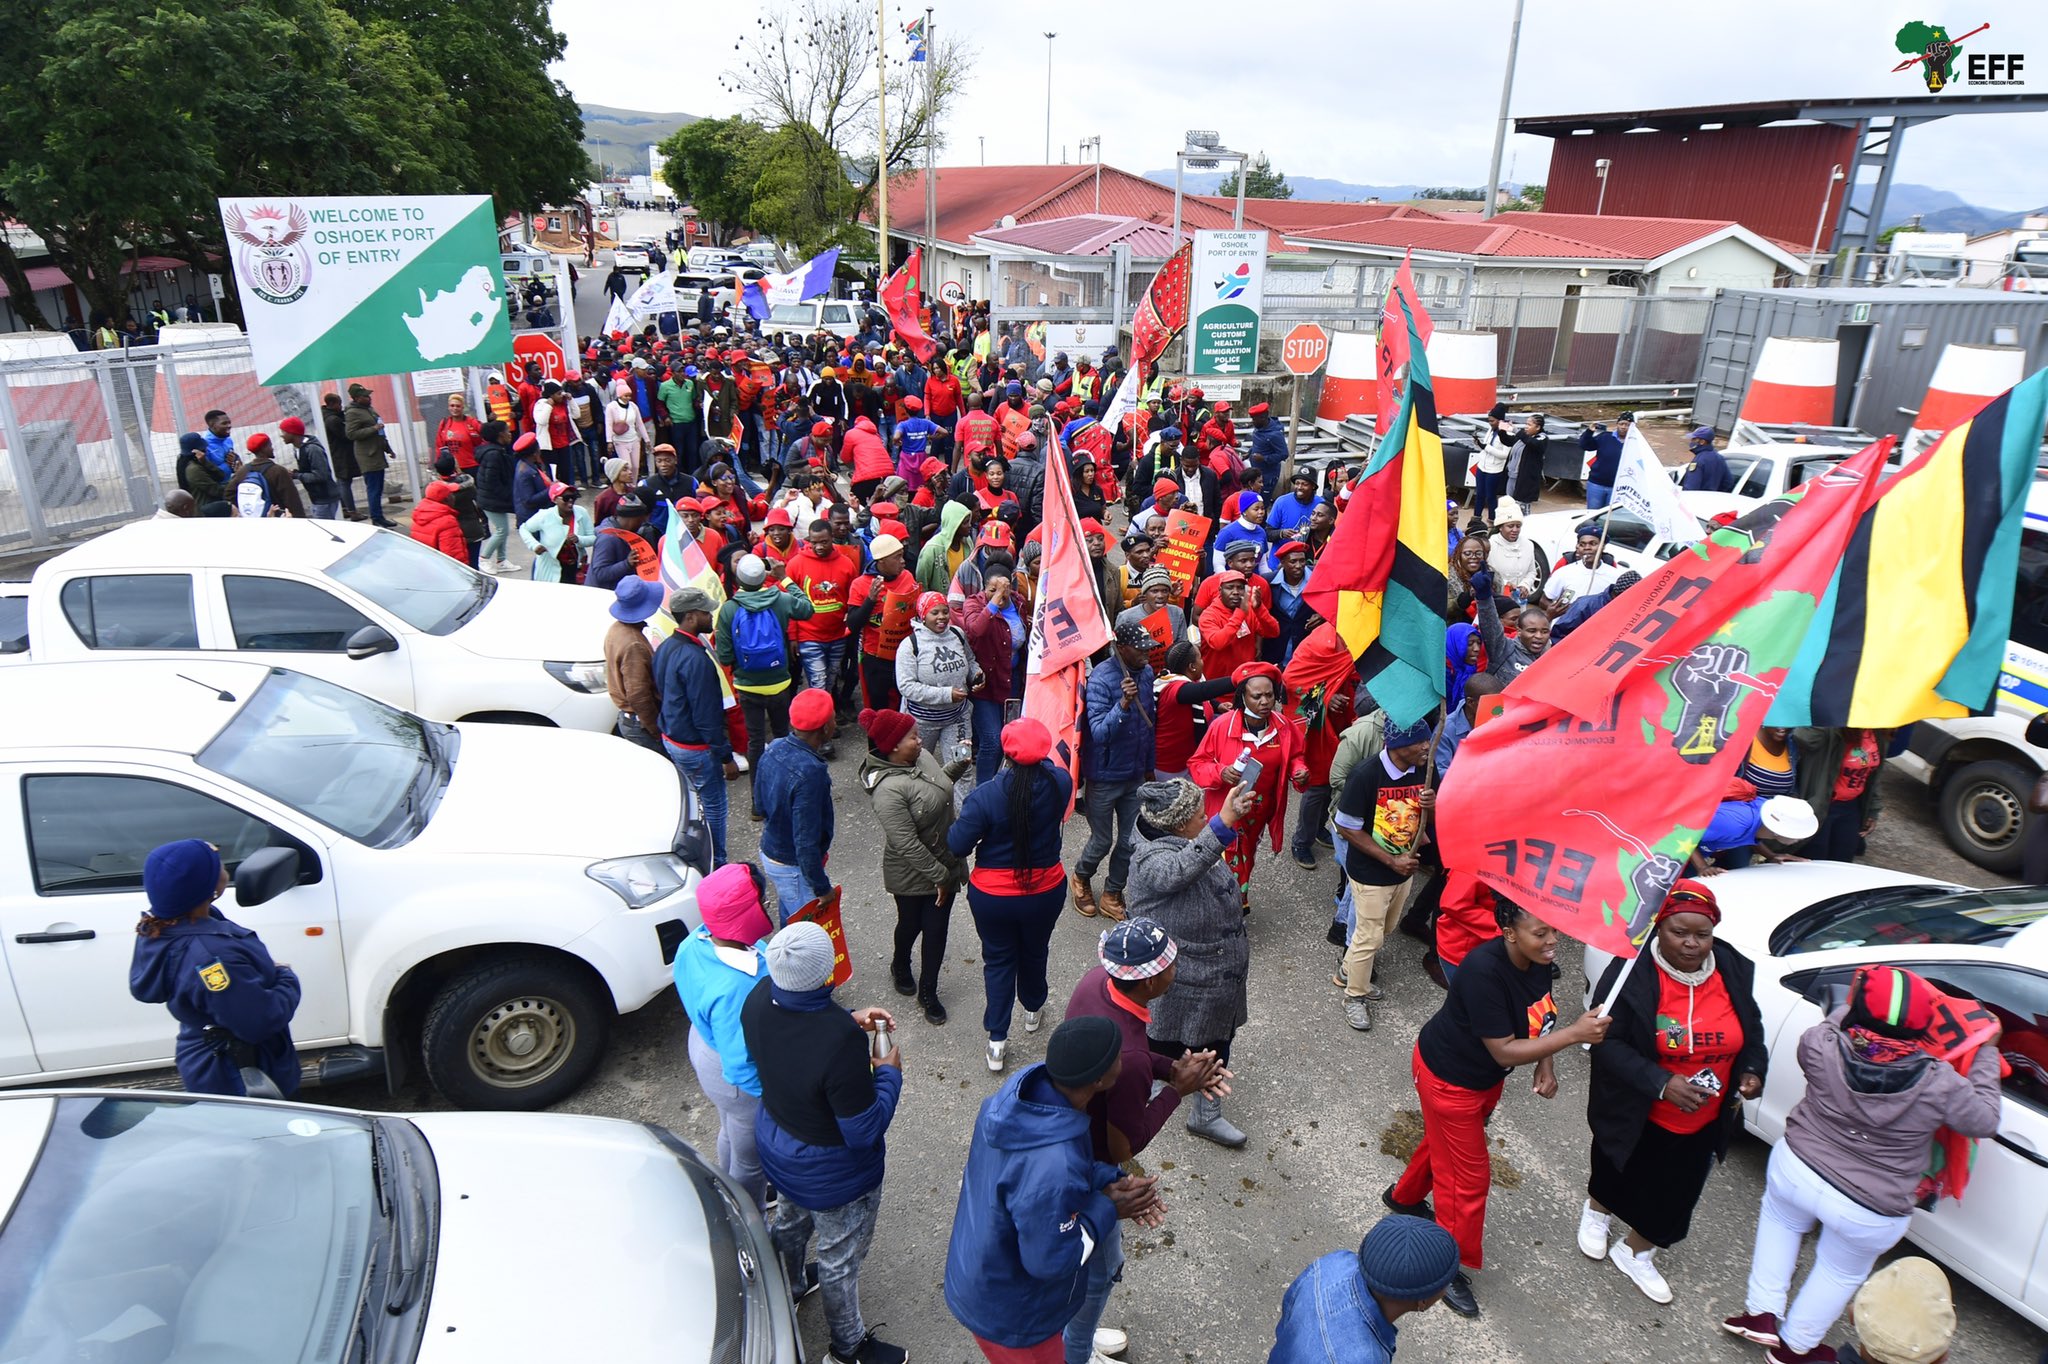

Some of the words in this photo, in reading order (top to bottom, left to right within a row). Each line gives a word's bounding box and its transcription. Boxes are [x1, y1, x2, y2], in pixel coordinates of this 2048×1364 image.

[309, 208, 399, 224] WELCOME
[402, 207, 424, 221] TO
[314, 228, 388, 245] OSHOEK
[392, 227, 435, 242] PORT
[1213, 232, 1248, 240] WELCOME
[318, 251, 342, 265] OF
[346, 248, 401, 264] ENTRY
[1208, 249, 1227, 257] PORT
[1228, 249, 1238, 257] OF
[946, 289, 958, 298] 40
[1202, 321, 1254, 330] AGRICULTURE
[1214, 339, 1243, 347] HEALTH
[1202, 347, 1251, 355] IMMIGRATION
[1286, 338, 1324, 359] STOP
[1201, 383, 1241, 391] Immigration
[1188, 528, 1200, 537] EFF
[1169, 538, 1178, 546] WE
[1161, 547, 1199, 561] DEMOCRACY
[1172, 559, 1180, 567] IN
[1638, 569, 1675, 613] ECONOMIC
[1152, 626, 1165, 637] EFF
[933, 658, 966, 674] Kappa
[1378, 785, 1421, 800] PUDEM
[1693, 1031, 1725, 1046] EFF
